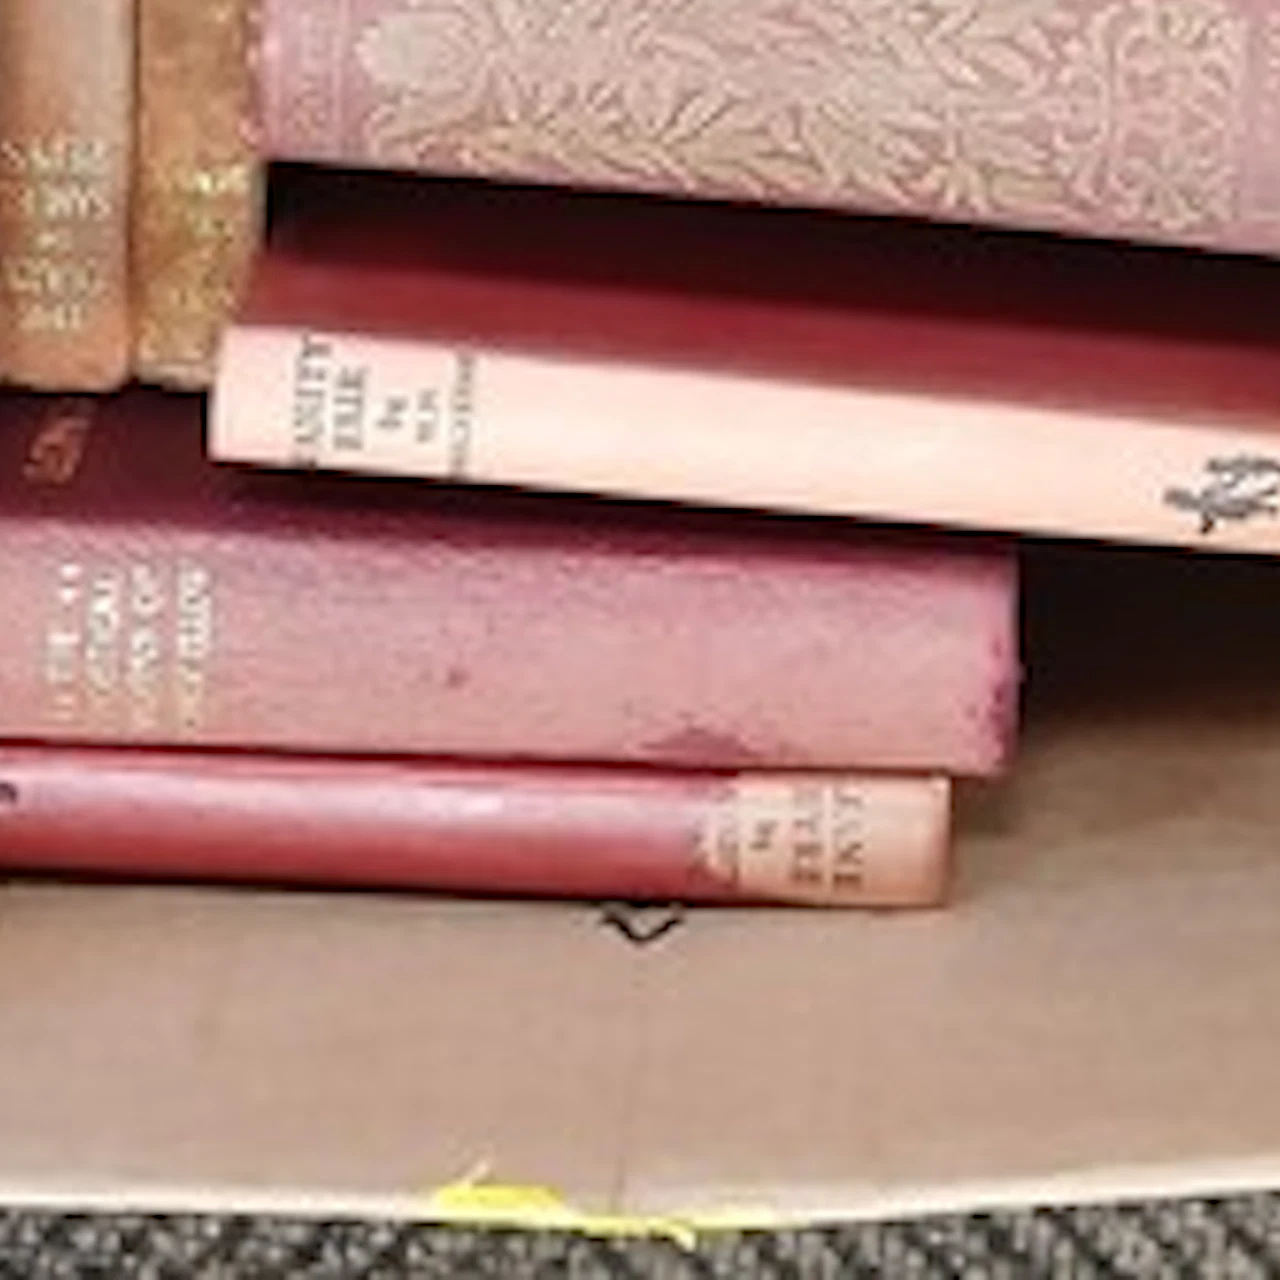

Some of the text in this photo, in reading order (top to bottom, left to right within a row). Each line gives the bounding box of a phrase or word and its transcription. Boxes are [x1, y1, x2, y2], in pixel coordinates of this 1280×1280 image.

[333, 366, 365, 453] FAIR
[374, 396, 408, 431] by
[749, 819, 779, 851] by
[793, 789, 823, 884] EYRE
[833, 792, 865, 892] JANE
